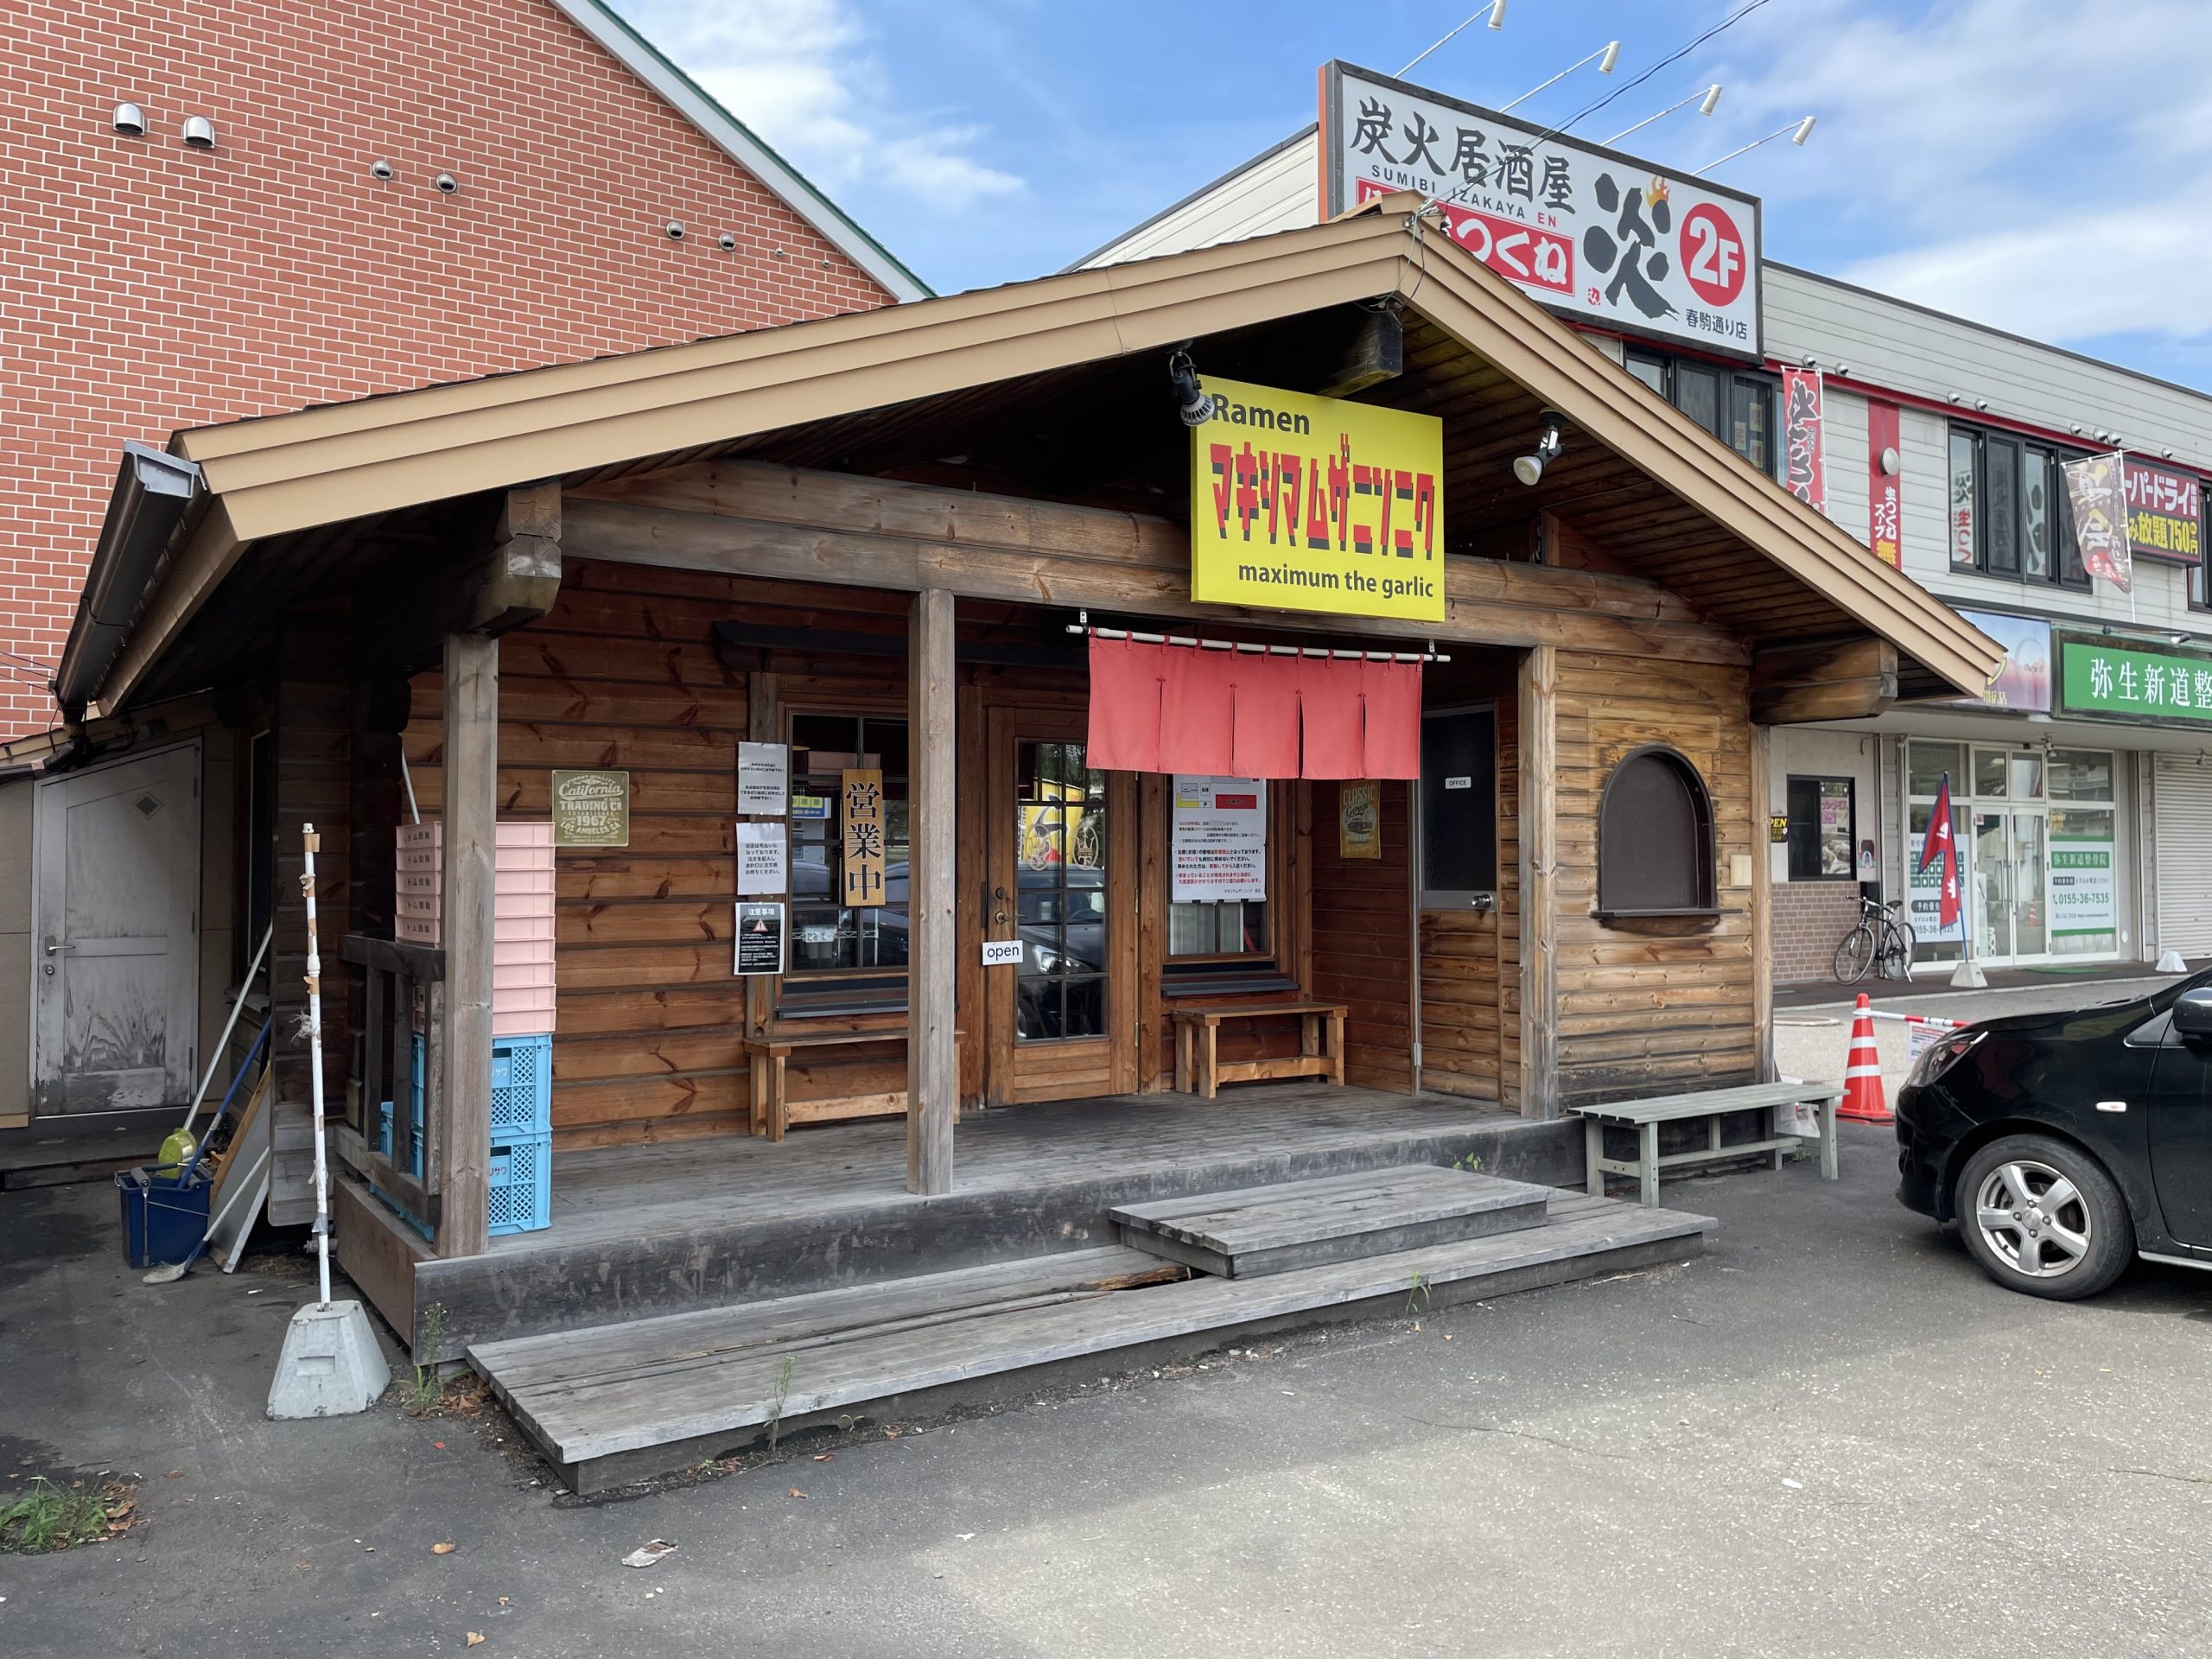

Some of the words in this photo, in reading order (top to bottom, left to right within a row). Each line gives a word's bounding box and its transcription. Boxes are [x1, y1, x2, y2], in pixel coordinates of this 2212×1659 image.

[1349, 95, 1576, 215] 炭火居酒屋
[1371, 164, 1435, 194] SUMIBI
[1452, 187, 1525, 219] IZAKAYA
[1537, 212, 1556, 228] EN
[1689, 216, 1738, 289] 2F
[1686, 308, 1748, 340] 春駒通り店
[1211, 393, 1310, 435] Ramen
[1238, 563, 1339, 589] maximum
[1344, 570, 1376, 592] the
[1382, 575, 1433, 599] garlic
[2090, 658, 2212, 709] 弥生新道整
[558, 782, 624, 798] California
[1343, 785, 1376, 805] CLASSIC
[559, 800, 608, 811] TRADING
[560, 821, 575, 832] LOS
[575, 825, 610, 835] ANGELES
[609, 821, 621, 830] CA
[576, 815, 607, 827] 1967
[1770, 817, 1788, 828] PEN
[846, 782, 881, 900] 営業中
[2058, 892, 2110, 905] 0155-36-7535
[987, 946, 1020, 961] open
